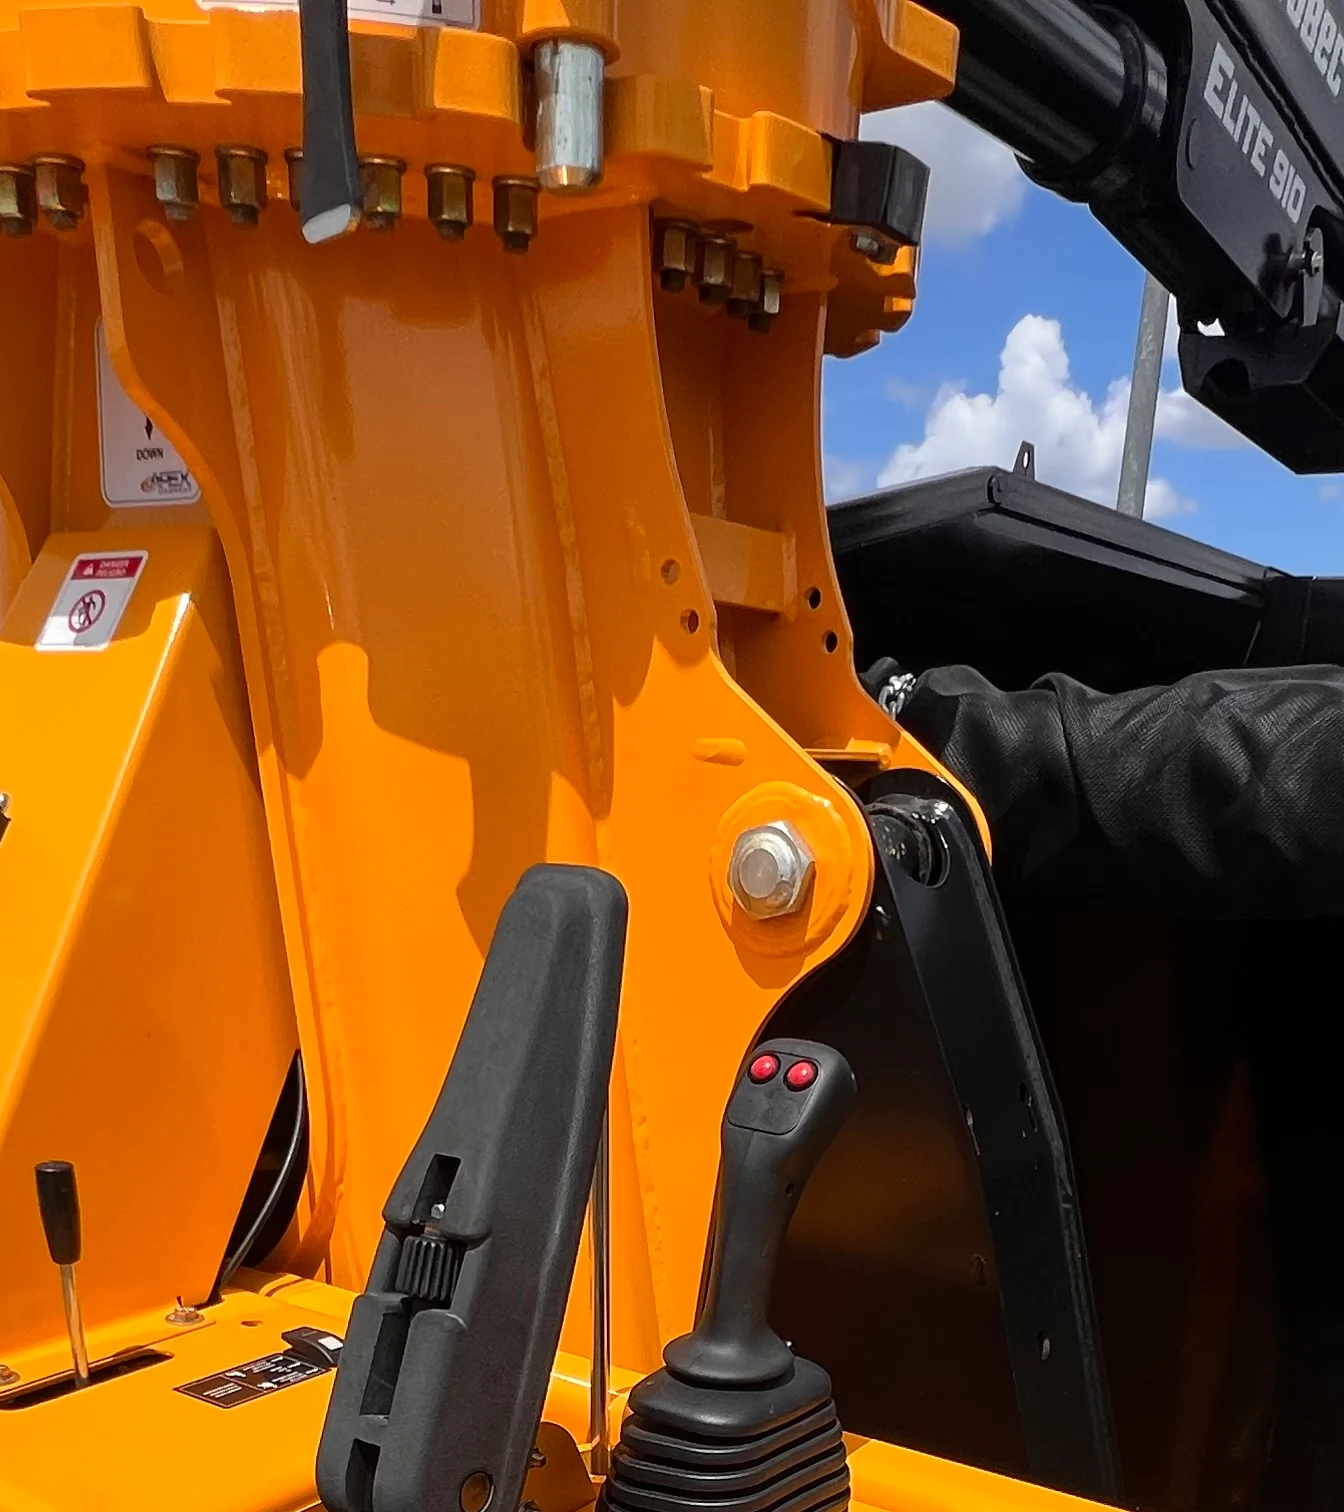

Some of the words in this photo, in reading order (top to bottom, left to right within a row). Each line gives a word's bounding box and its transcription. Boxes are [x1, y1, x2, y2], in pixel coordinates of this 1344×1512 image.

[1204, 42, 1274, 177] ELITE
[1269, 149, 1306, 224] 910
[136, 447, 164, 461] DOWN
